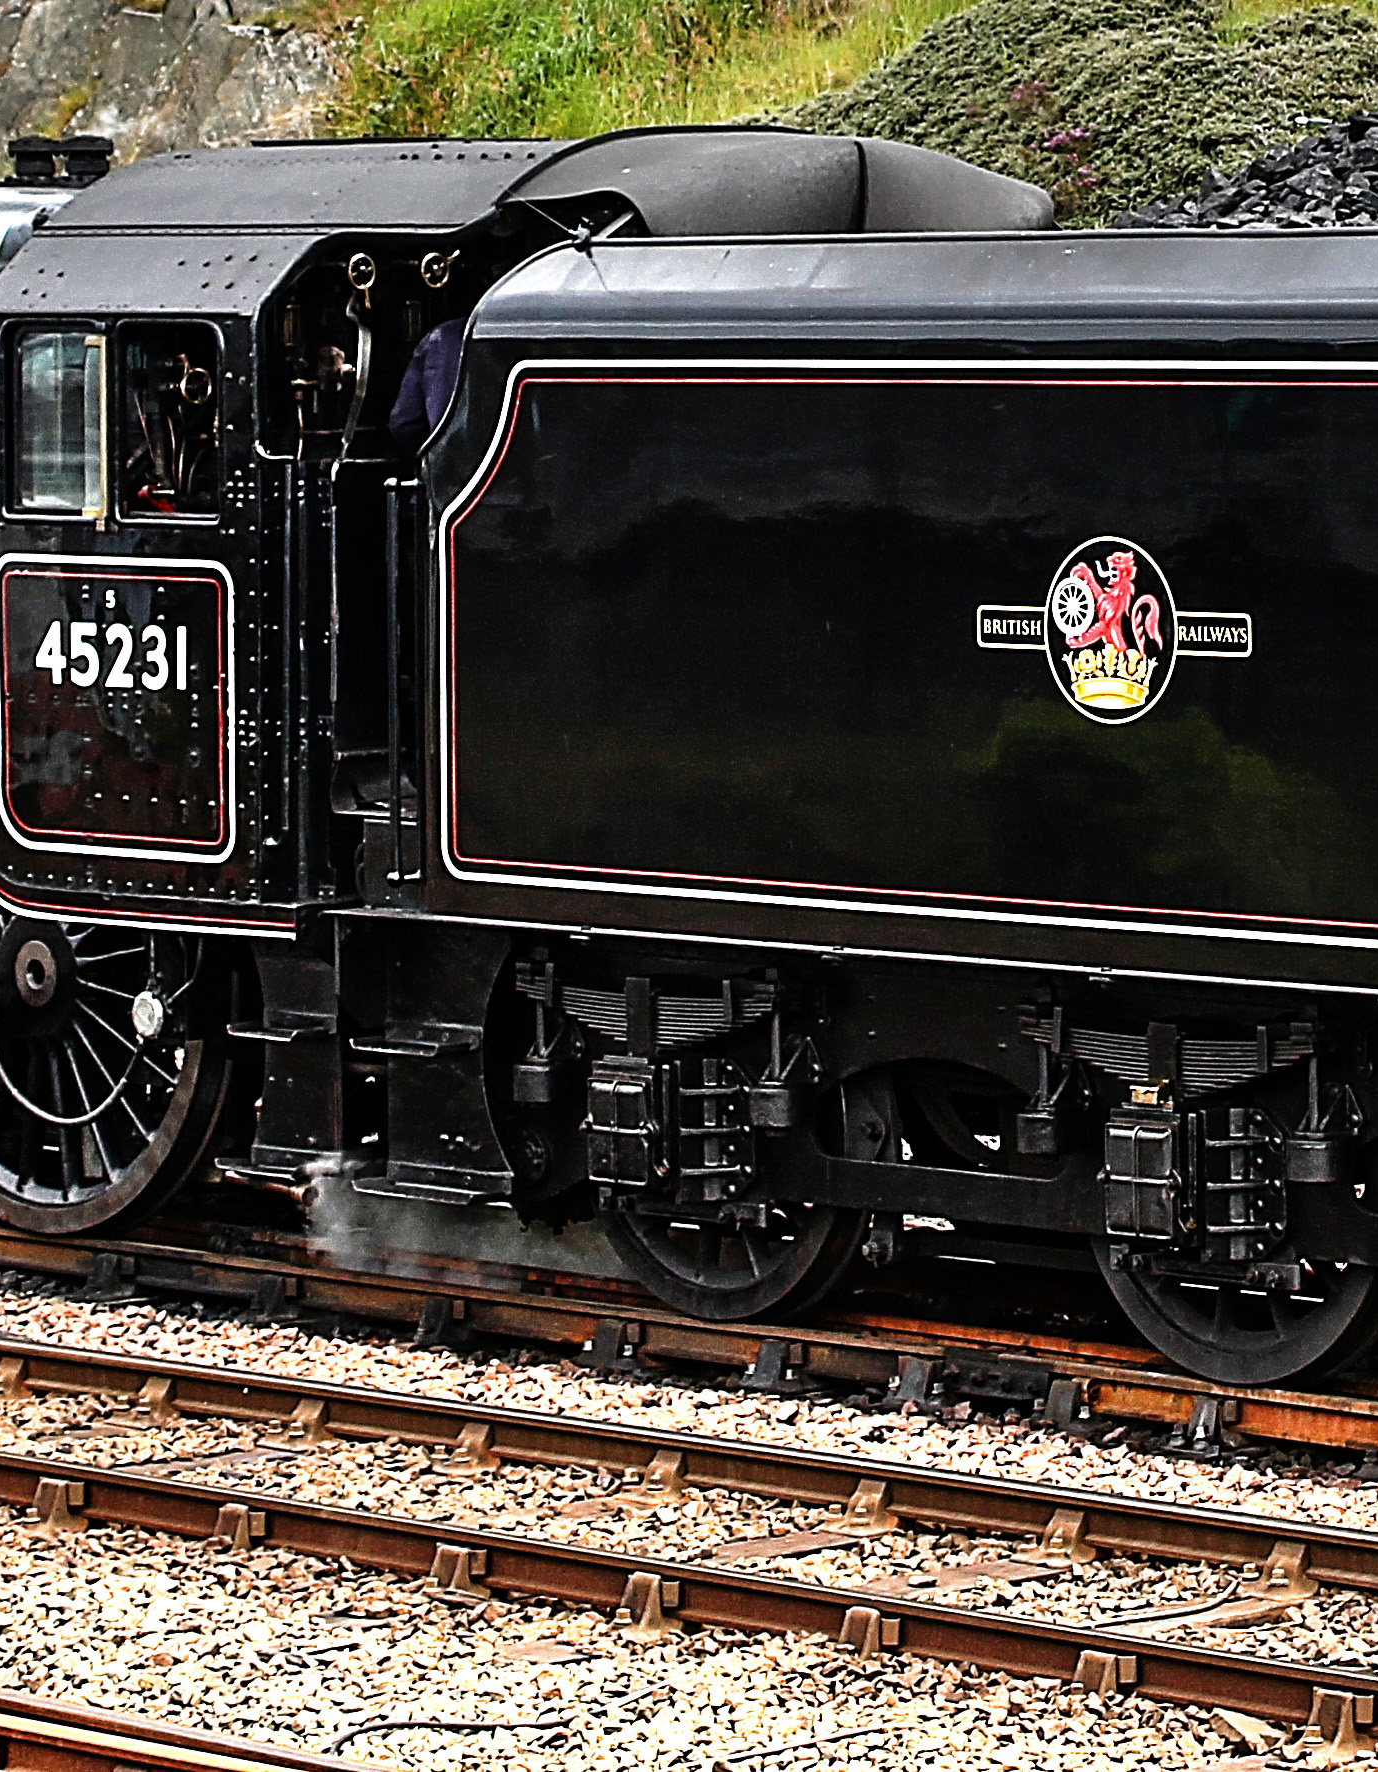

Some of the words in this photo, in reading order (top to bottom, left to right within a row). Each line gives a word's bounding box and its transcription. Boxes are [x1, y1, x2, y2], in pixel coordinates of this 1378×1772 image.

[983, 618, 1042, 637] BRITISH
[1178, 625, 1248, 644] RAILWAYS
[35, 620, 187, 691] 45231
